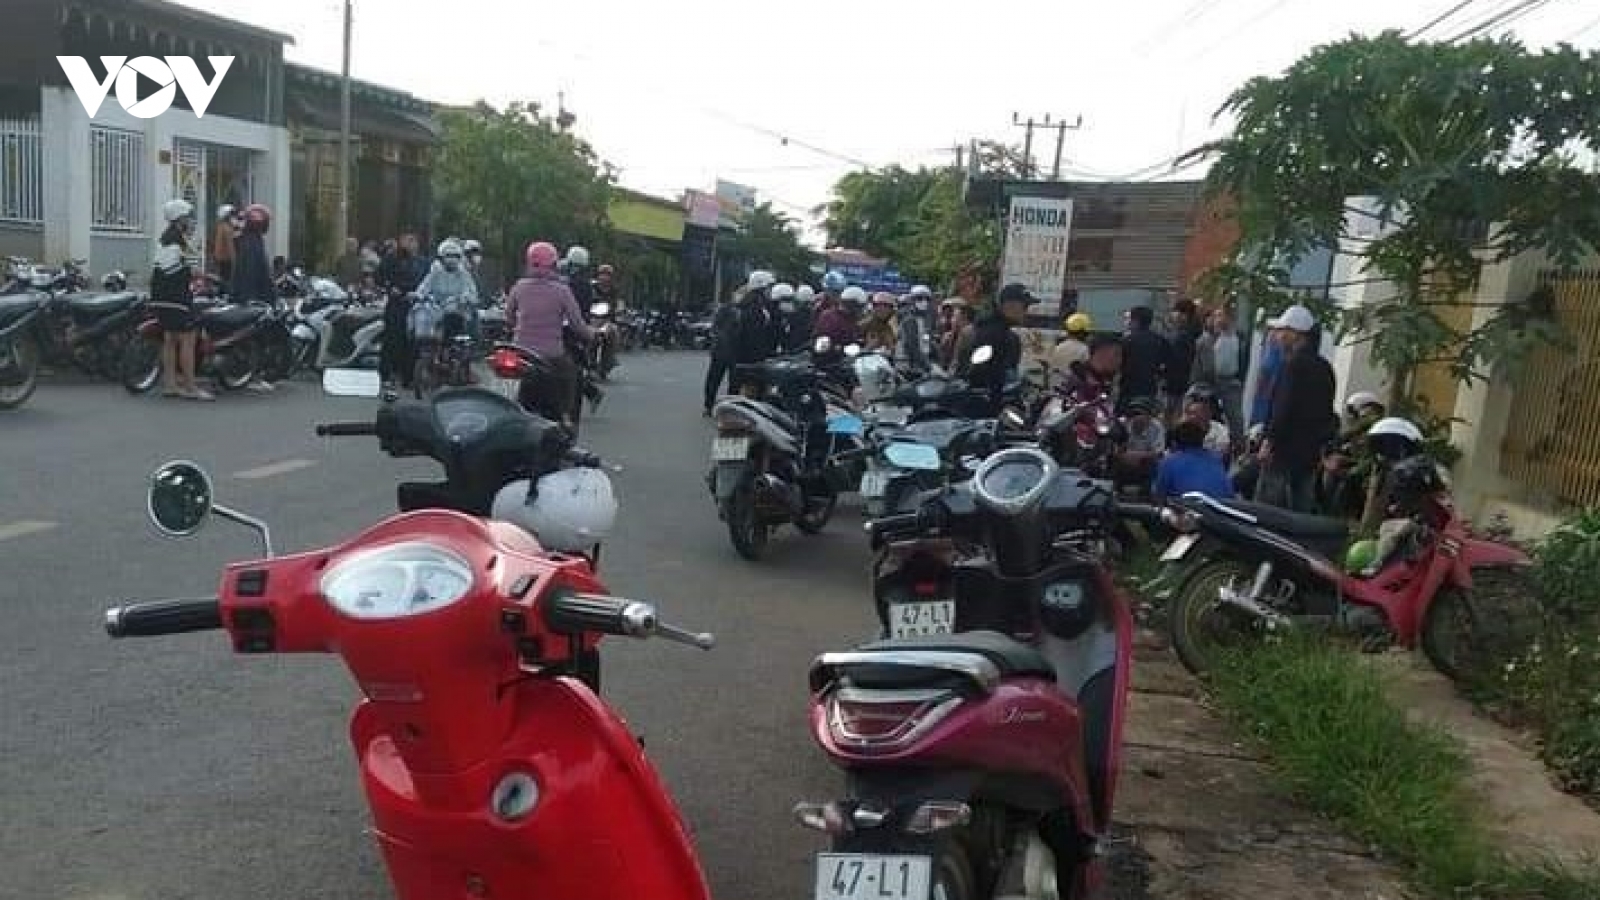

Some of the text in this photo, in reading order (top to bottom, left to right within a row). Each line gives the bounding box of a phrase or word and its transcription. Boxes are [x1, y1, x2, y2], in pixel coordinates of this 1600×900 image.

[1011, 206, 1068, 228] HONDA
[902, 603, 950, 625] 47-L1
[832, 860, 910, 897] 47-L1
